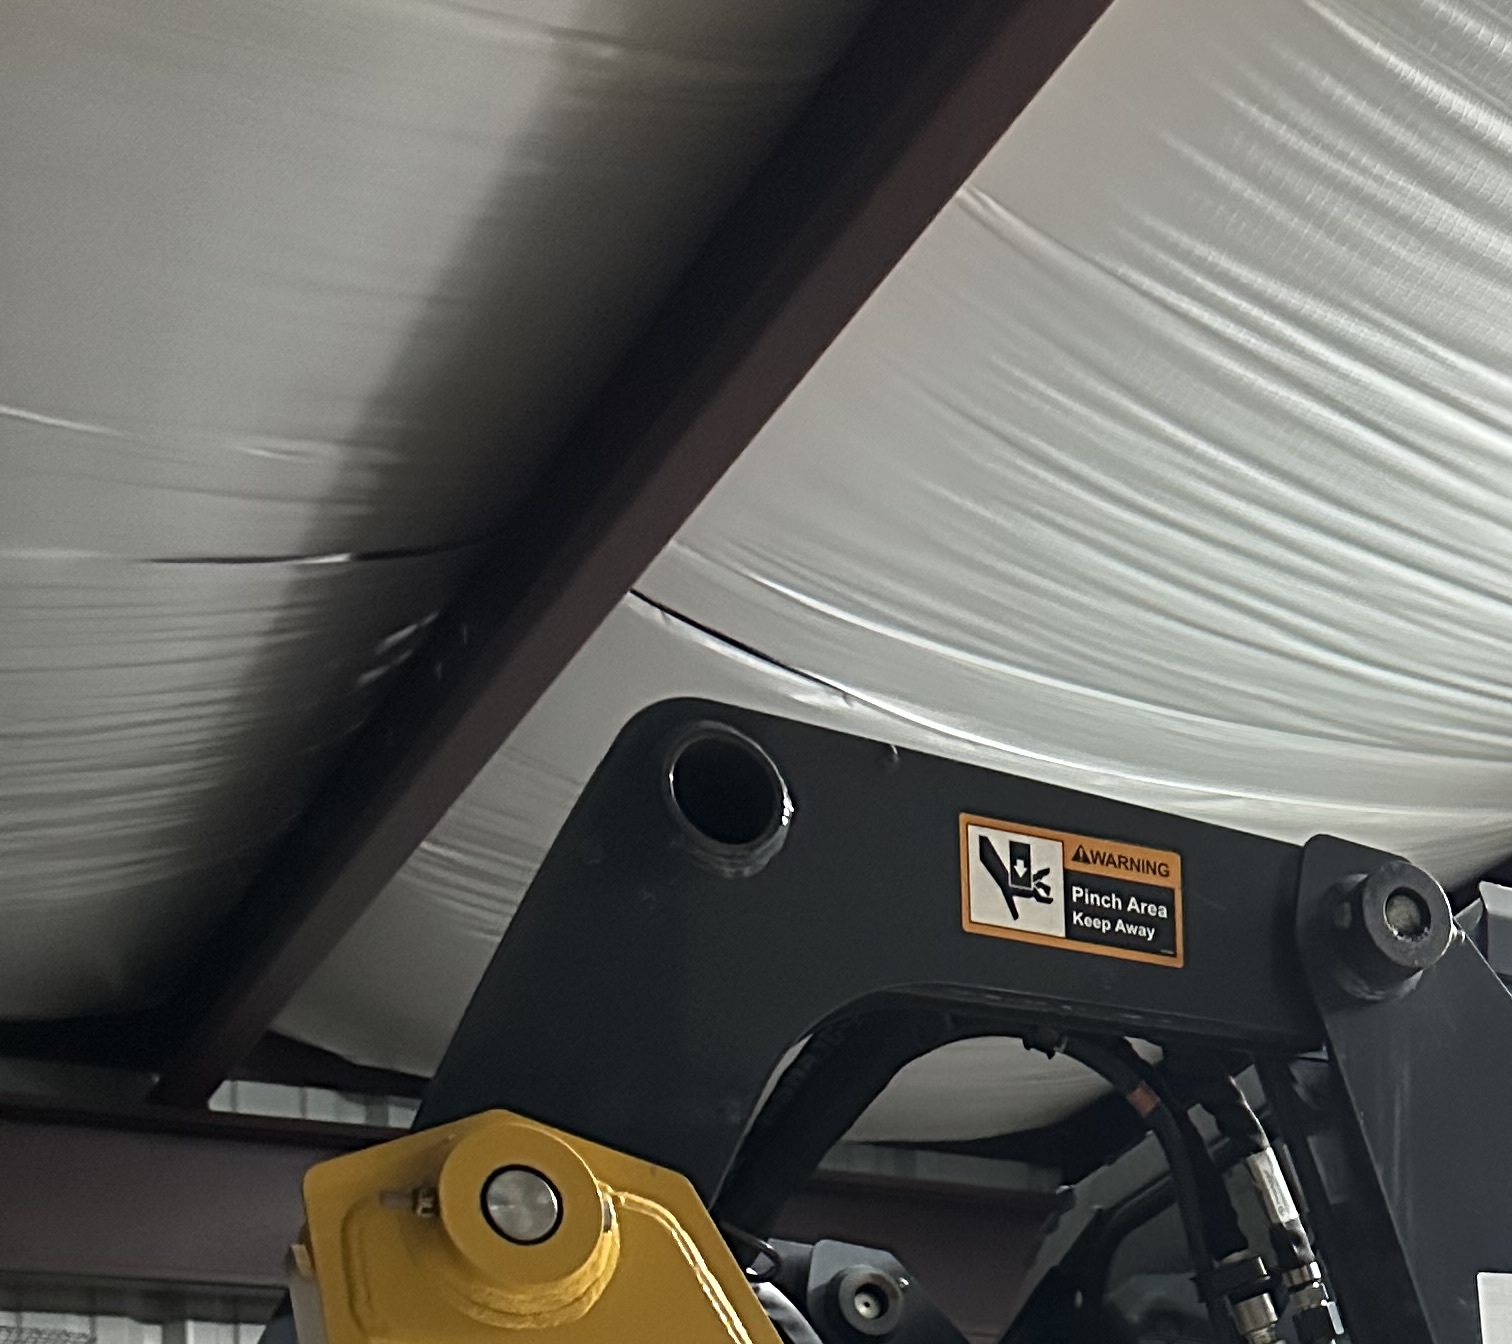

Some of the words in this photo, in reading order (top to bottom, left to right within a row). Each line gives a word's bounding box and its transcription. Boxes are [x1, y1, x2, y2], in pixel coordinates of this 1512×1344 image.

[1089, 850, 1170, 878] WARNING
[1072, 885, 1122, 911] Pinch
[1127, 896, 1168, 919] Area
[1072, 910, 1111, 933] Keep
[1115, 918, 1156, 941] Away
